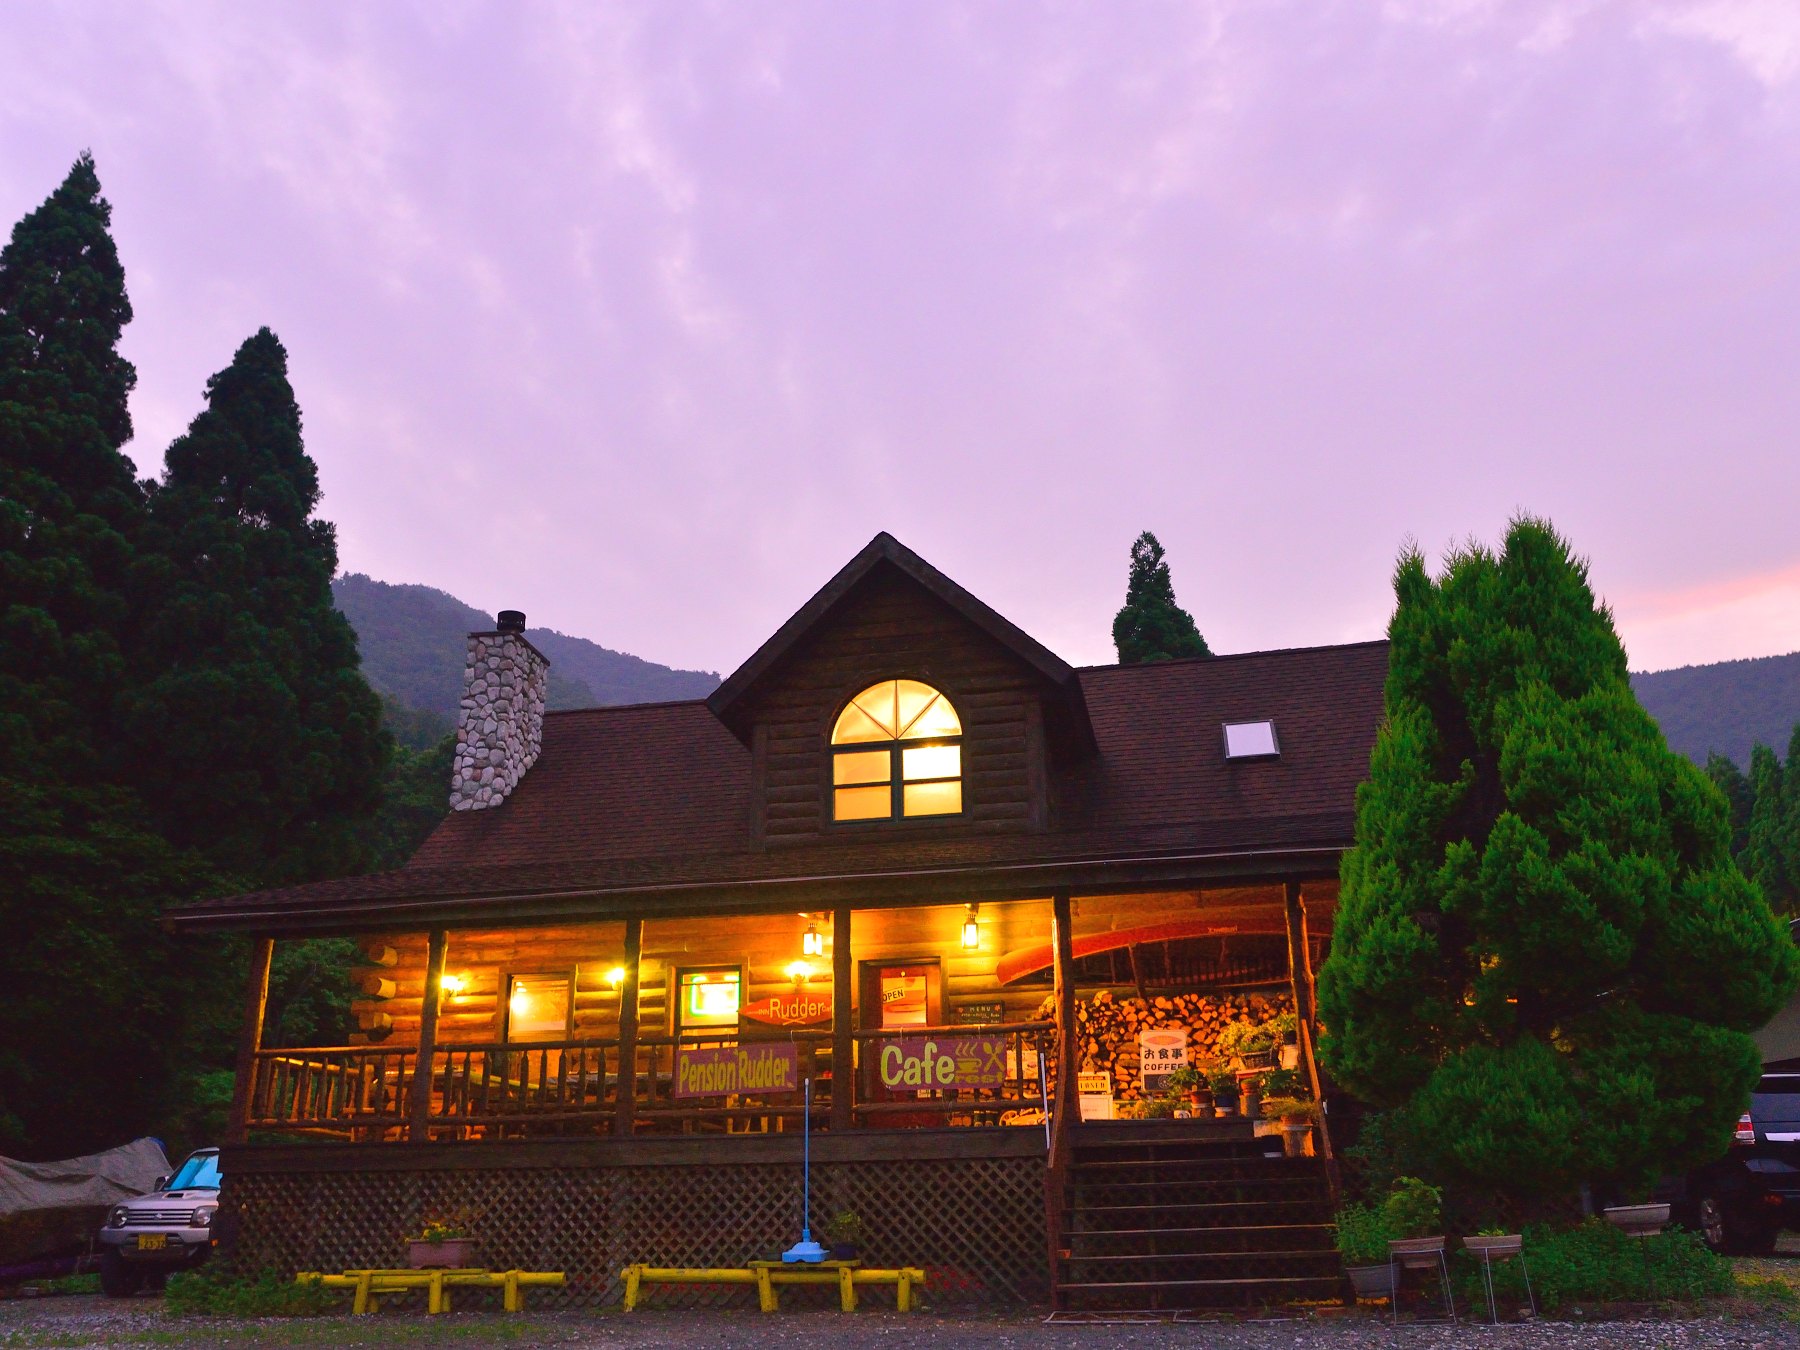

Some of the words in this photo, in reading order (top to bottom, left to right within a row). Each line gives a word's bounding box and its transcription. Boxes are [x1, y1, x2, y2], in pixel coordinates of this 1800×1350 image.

[882, 989, 904, 1001] OPEN
[769, 997, 824, 1018] Rudder
[880, 1042, 955, 1086] Cafe
[1144, 1048, 1183, 1060] お食事
[679, 1053, 736, 1093] Pension
[739, 1048, 790, 1090] Rudder
